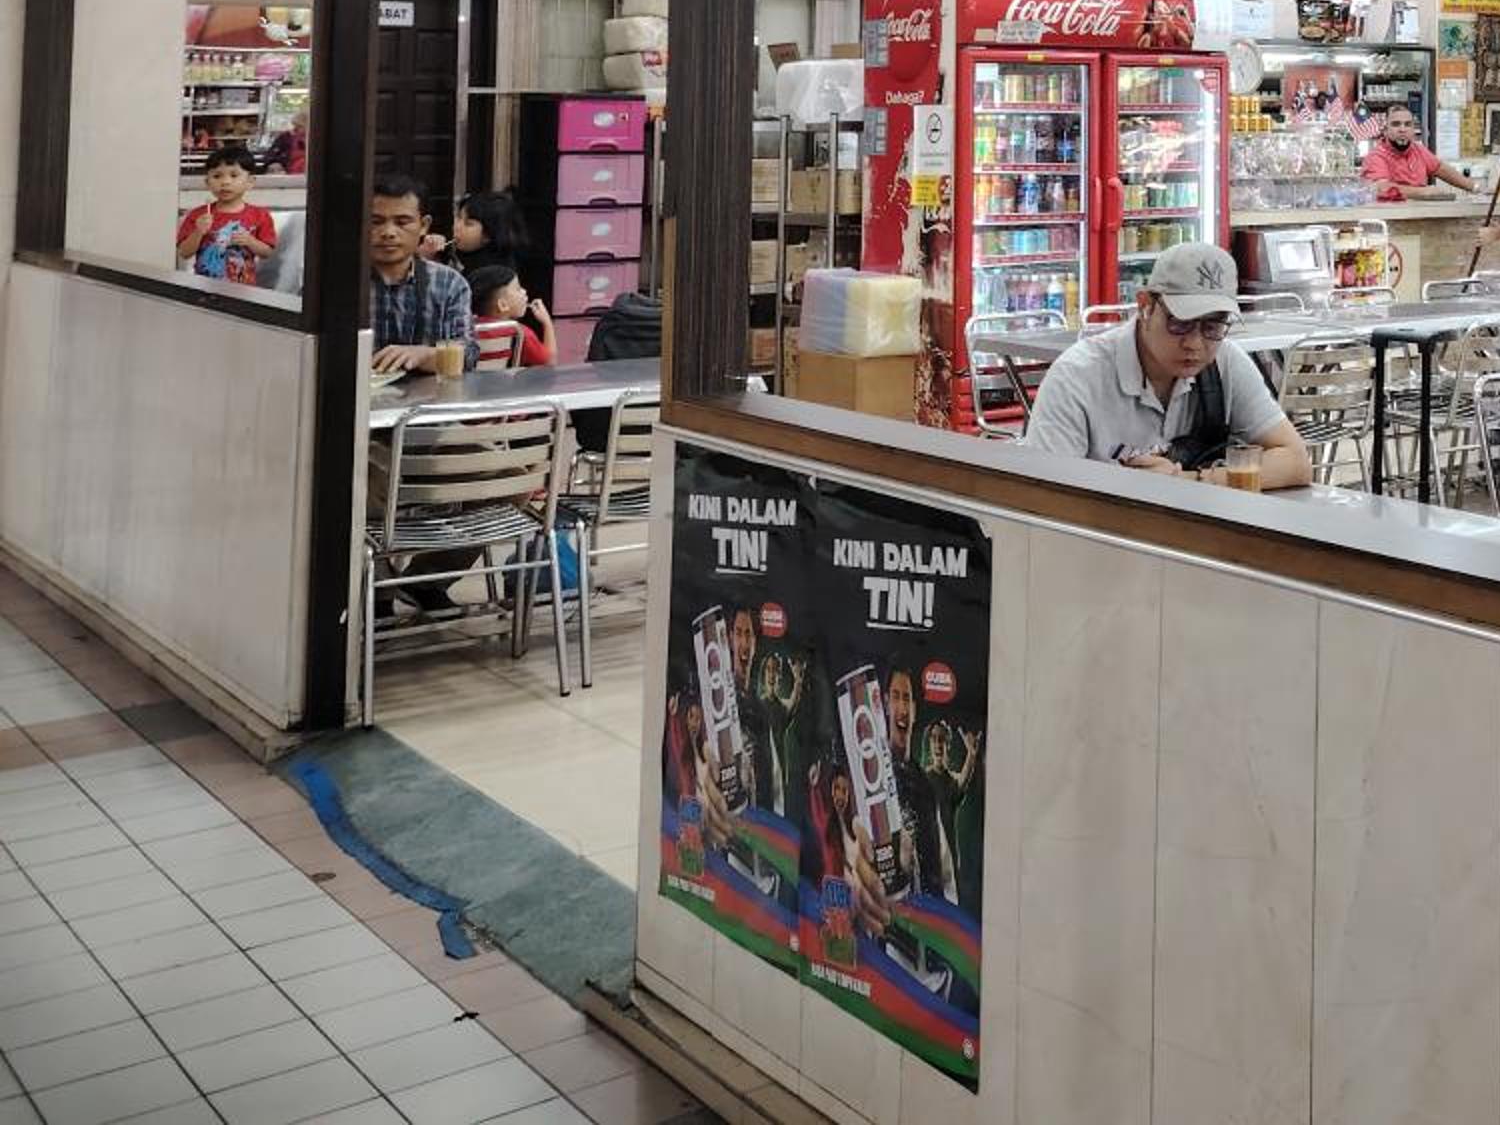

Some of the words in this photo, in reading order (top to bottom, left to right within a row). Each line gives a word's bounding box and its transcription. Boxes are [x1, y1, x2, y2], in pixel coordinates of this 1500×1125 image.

[688, 494, 722, 521] KINI
[727, 497, 796, 525] DALAM
[712, 527, 768, 572] TIN!
[834, 538, 876, 569] KINI
[883, 543, 968, 577] DALAM
[863, 576, 934, 627] TIN!
